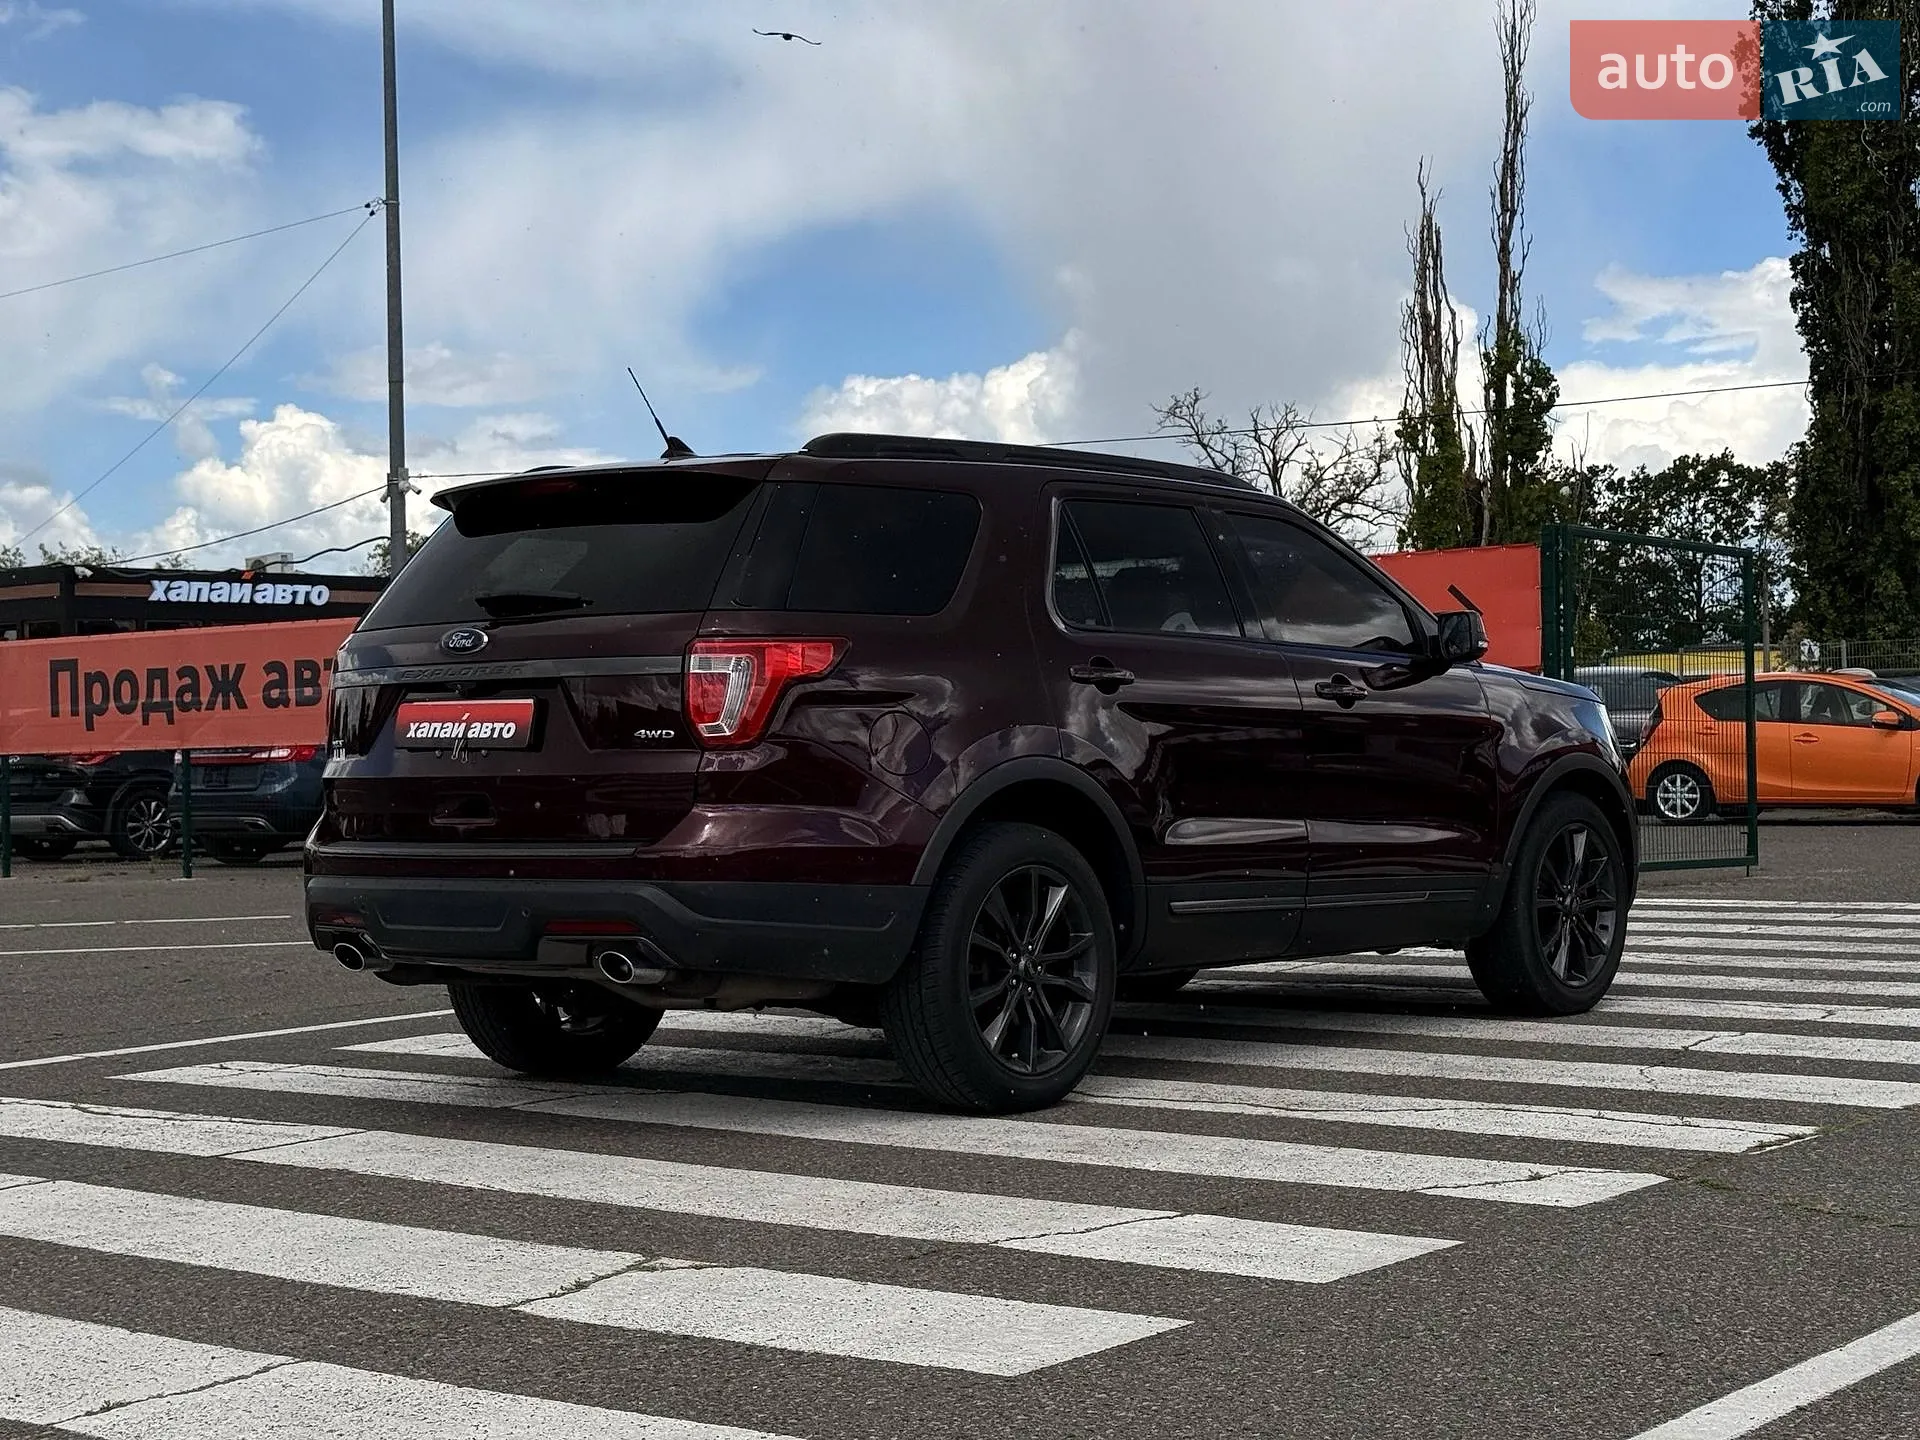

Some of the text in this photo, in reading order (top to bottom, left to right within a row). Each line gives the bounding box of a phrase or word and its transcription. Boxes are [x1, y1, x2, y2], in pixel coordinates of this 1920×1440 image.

[448, 631, 475, 648] Ford
[402, 664, 525, 680] EXPLORER
[49, 657, 248, 732] Продаж
[406, 712, 516, 739] хапай авто
[633, 729, 675, 739] 4WD
